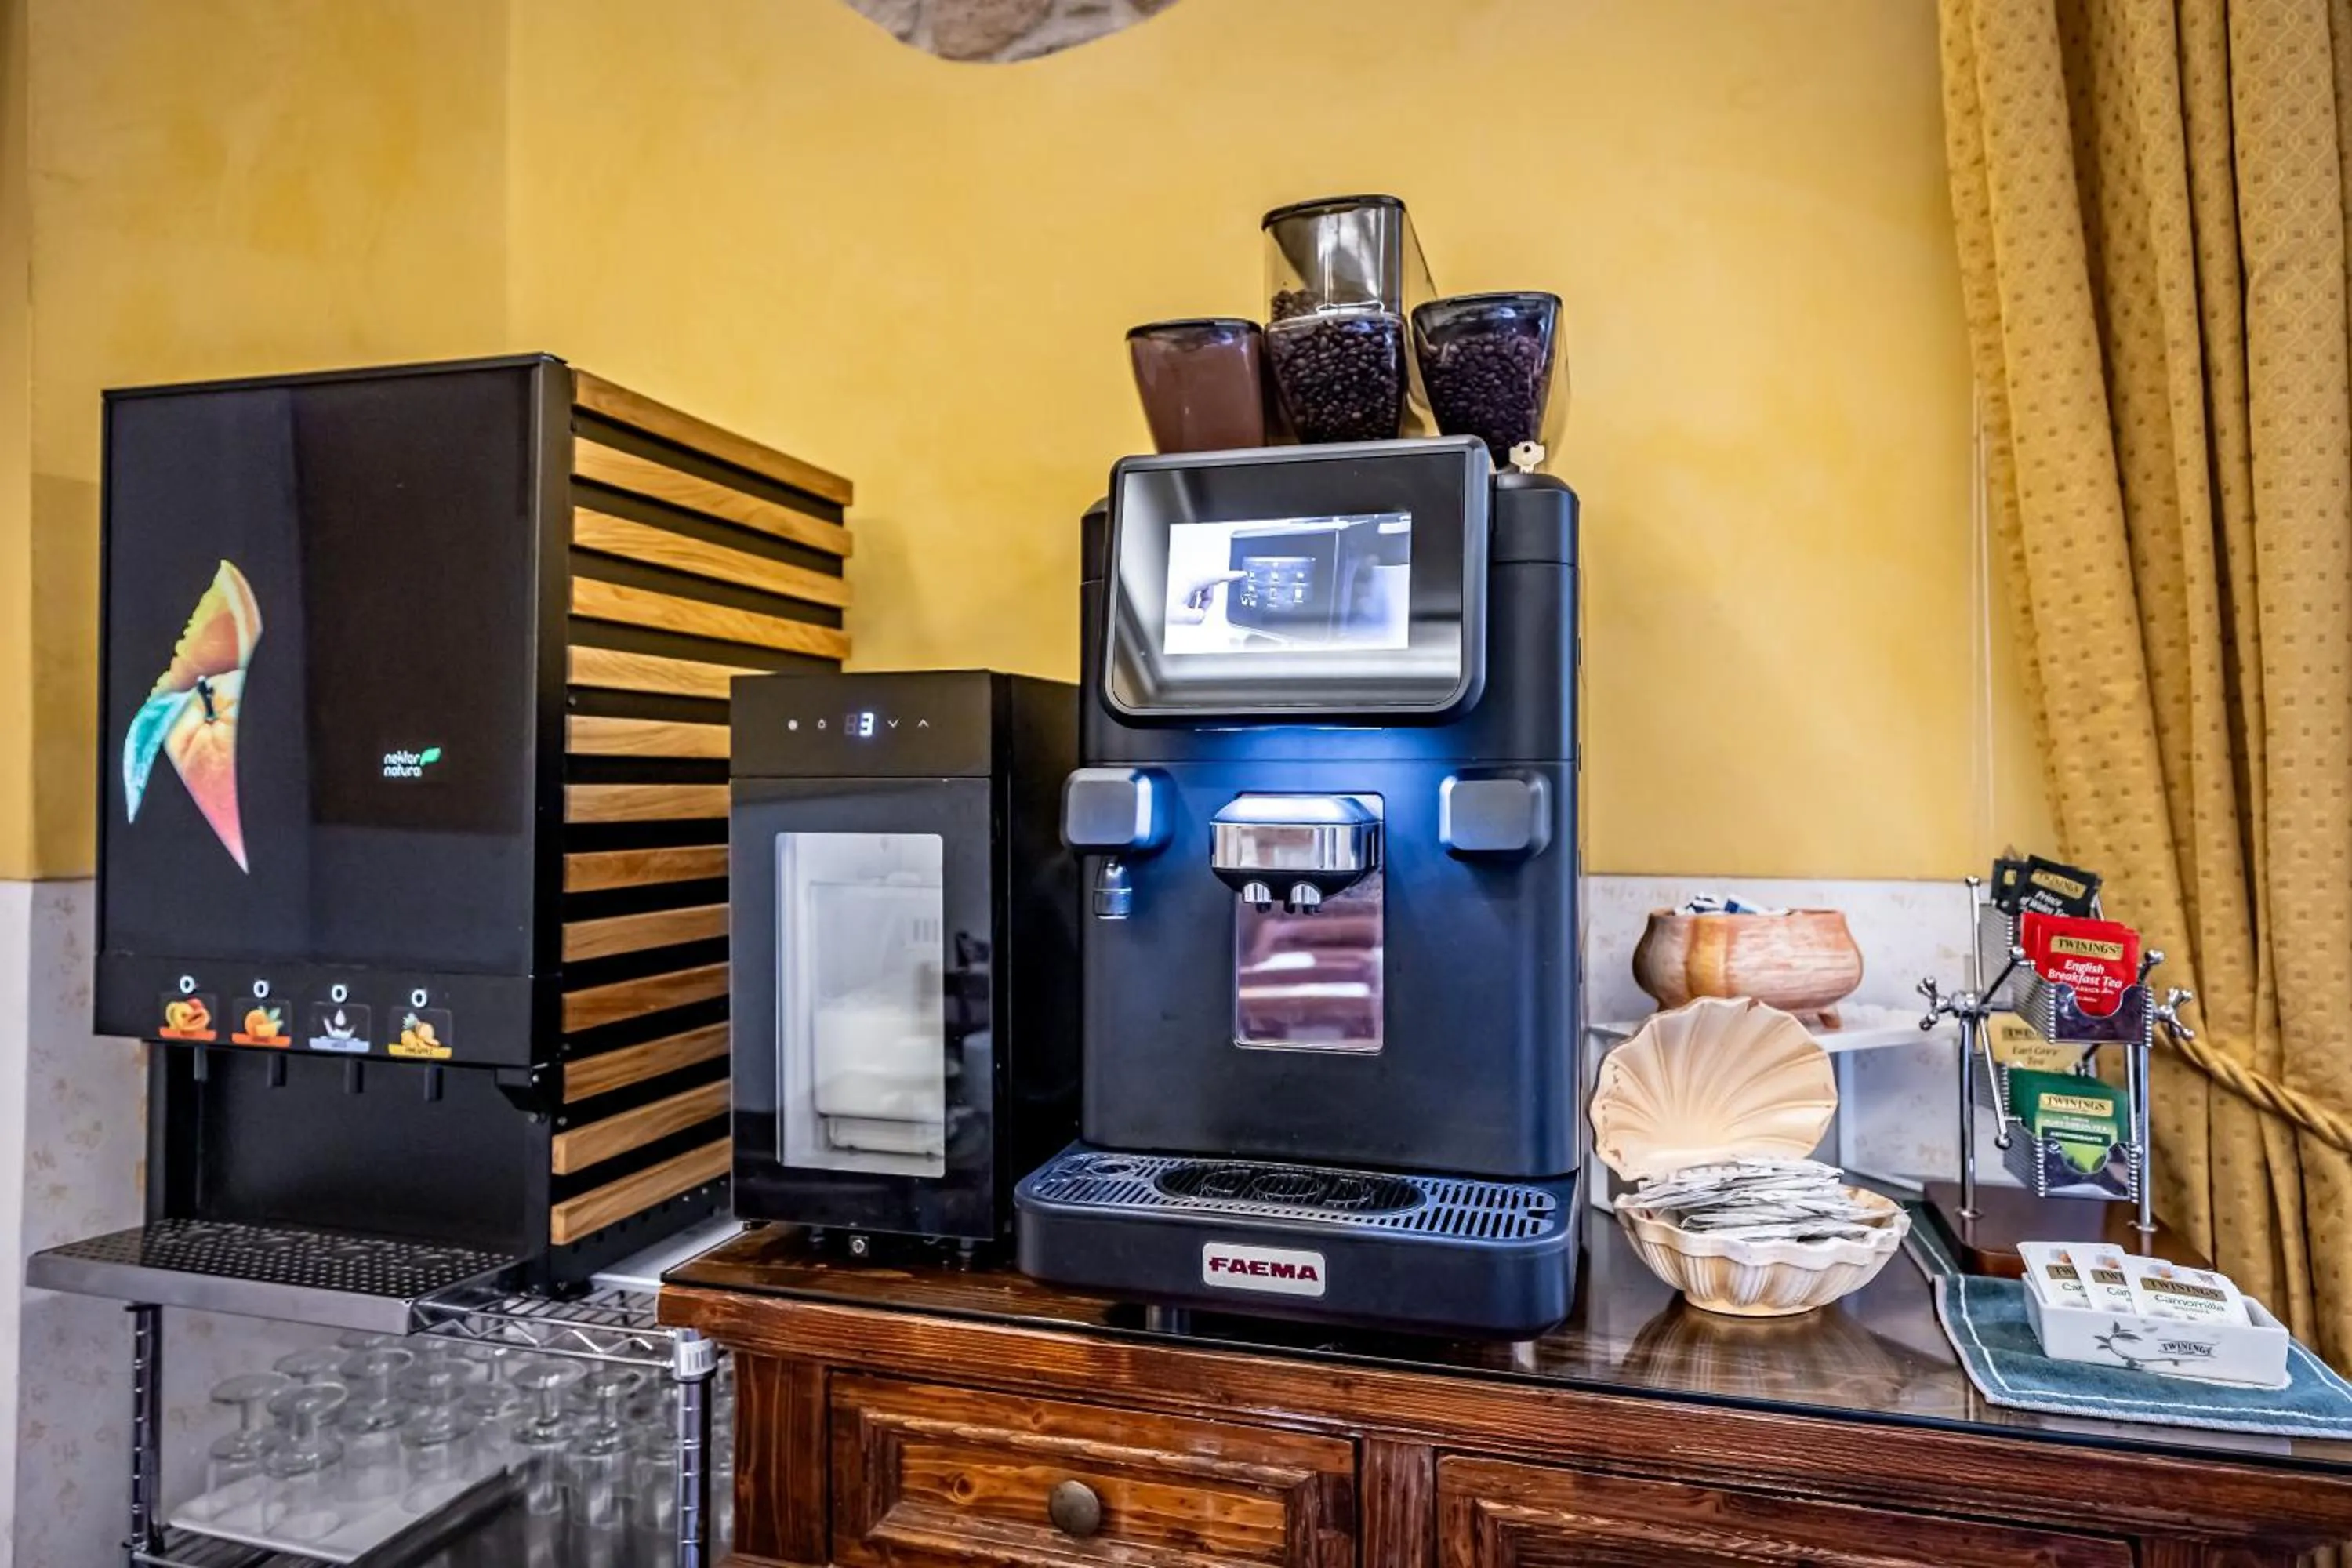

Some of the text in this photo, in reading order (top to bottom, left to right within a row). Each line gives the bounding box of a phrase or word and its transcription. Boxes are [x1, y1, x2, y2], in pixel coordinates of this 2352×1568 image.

[383, 750, 420, 764] nektar
[383, 764, 423, 777] natura
[2058, 938, 2117, 954] TWININGS
[2064, 959, 2104, 975] English
[2048, 968, 2122, 989] Breakfast Tea
[2047, 1096, 2107, 1111] TWININGS
[1209, 1257, 1319, 1282] FAEMA
[2150, 1278, 2219, 1298] TWININGS
[2154, 1294, 2225, 1312] Camomilla
[2161, 1341, 2212, 1356] TWININGS
